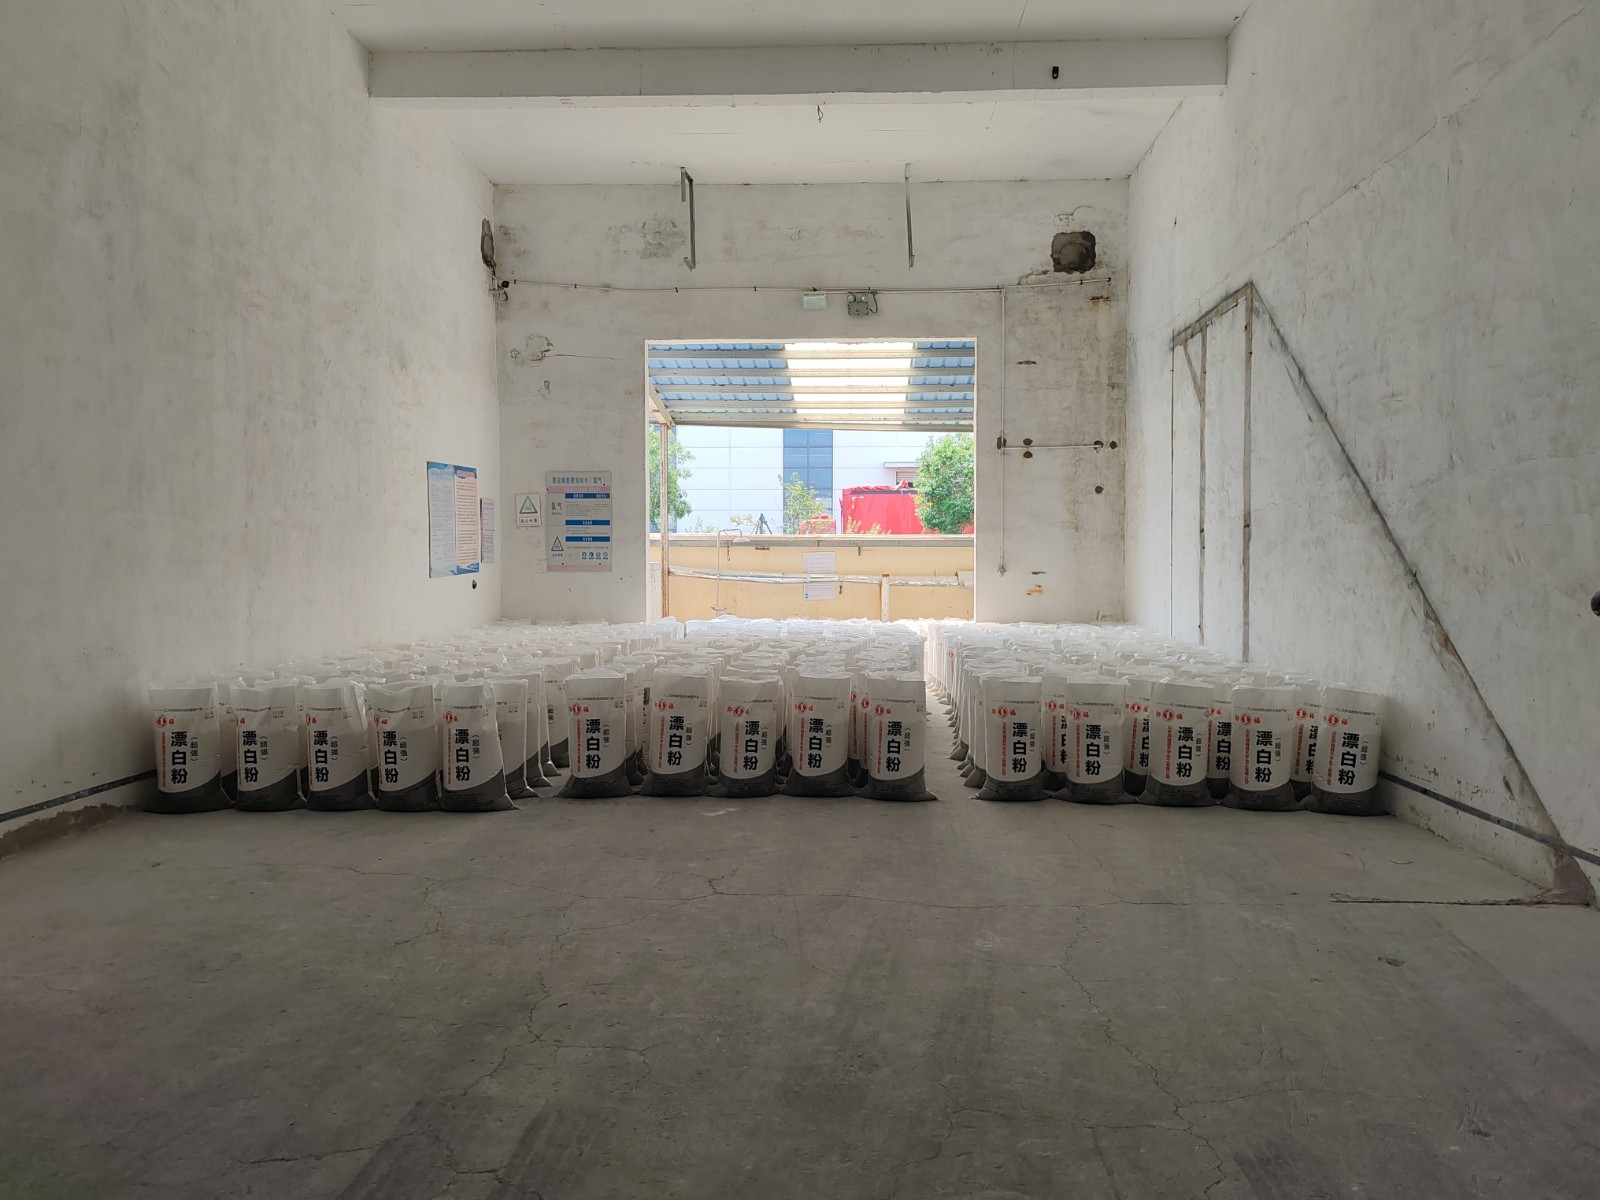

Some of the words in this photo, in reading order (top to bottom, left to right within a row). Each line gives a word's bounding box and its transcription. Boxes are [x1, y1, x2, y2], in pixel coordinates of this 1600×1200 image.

[171, 732, 188, 784] 漂白粉
[243, 731, 258, 782] 漂白粉
[314, 731, 329, 782] 漂白粉
[382, 731, 398, 783] 漂白粉
[455, 729, 470, 781] 漂白粉
[586, 719, 601, 769] 漂白粉
[667, 716, 684, 765] 漂白粉
[743, 721, 759, 770] 漂白粉
[808, 719, 823, 768] 漂白粉
[886, 721, 902, 772] 漂白粉
[1012, 723, 1027, 773] 漂白粉
[1086, 725, 1101, 775] 漂白粉
[1177, 727, 1193, 777] 漂白粉
[1255, 731, 1272, 782] 漂白粉
[1338, 732, 1359, 785] 漂白粉
